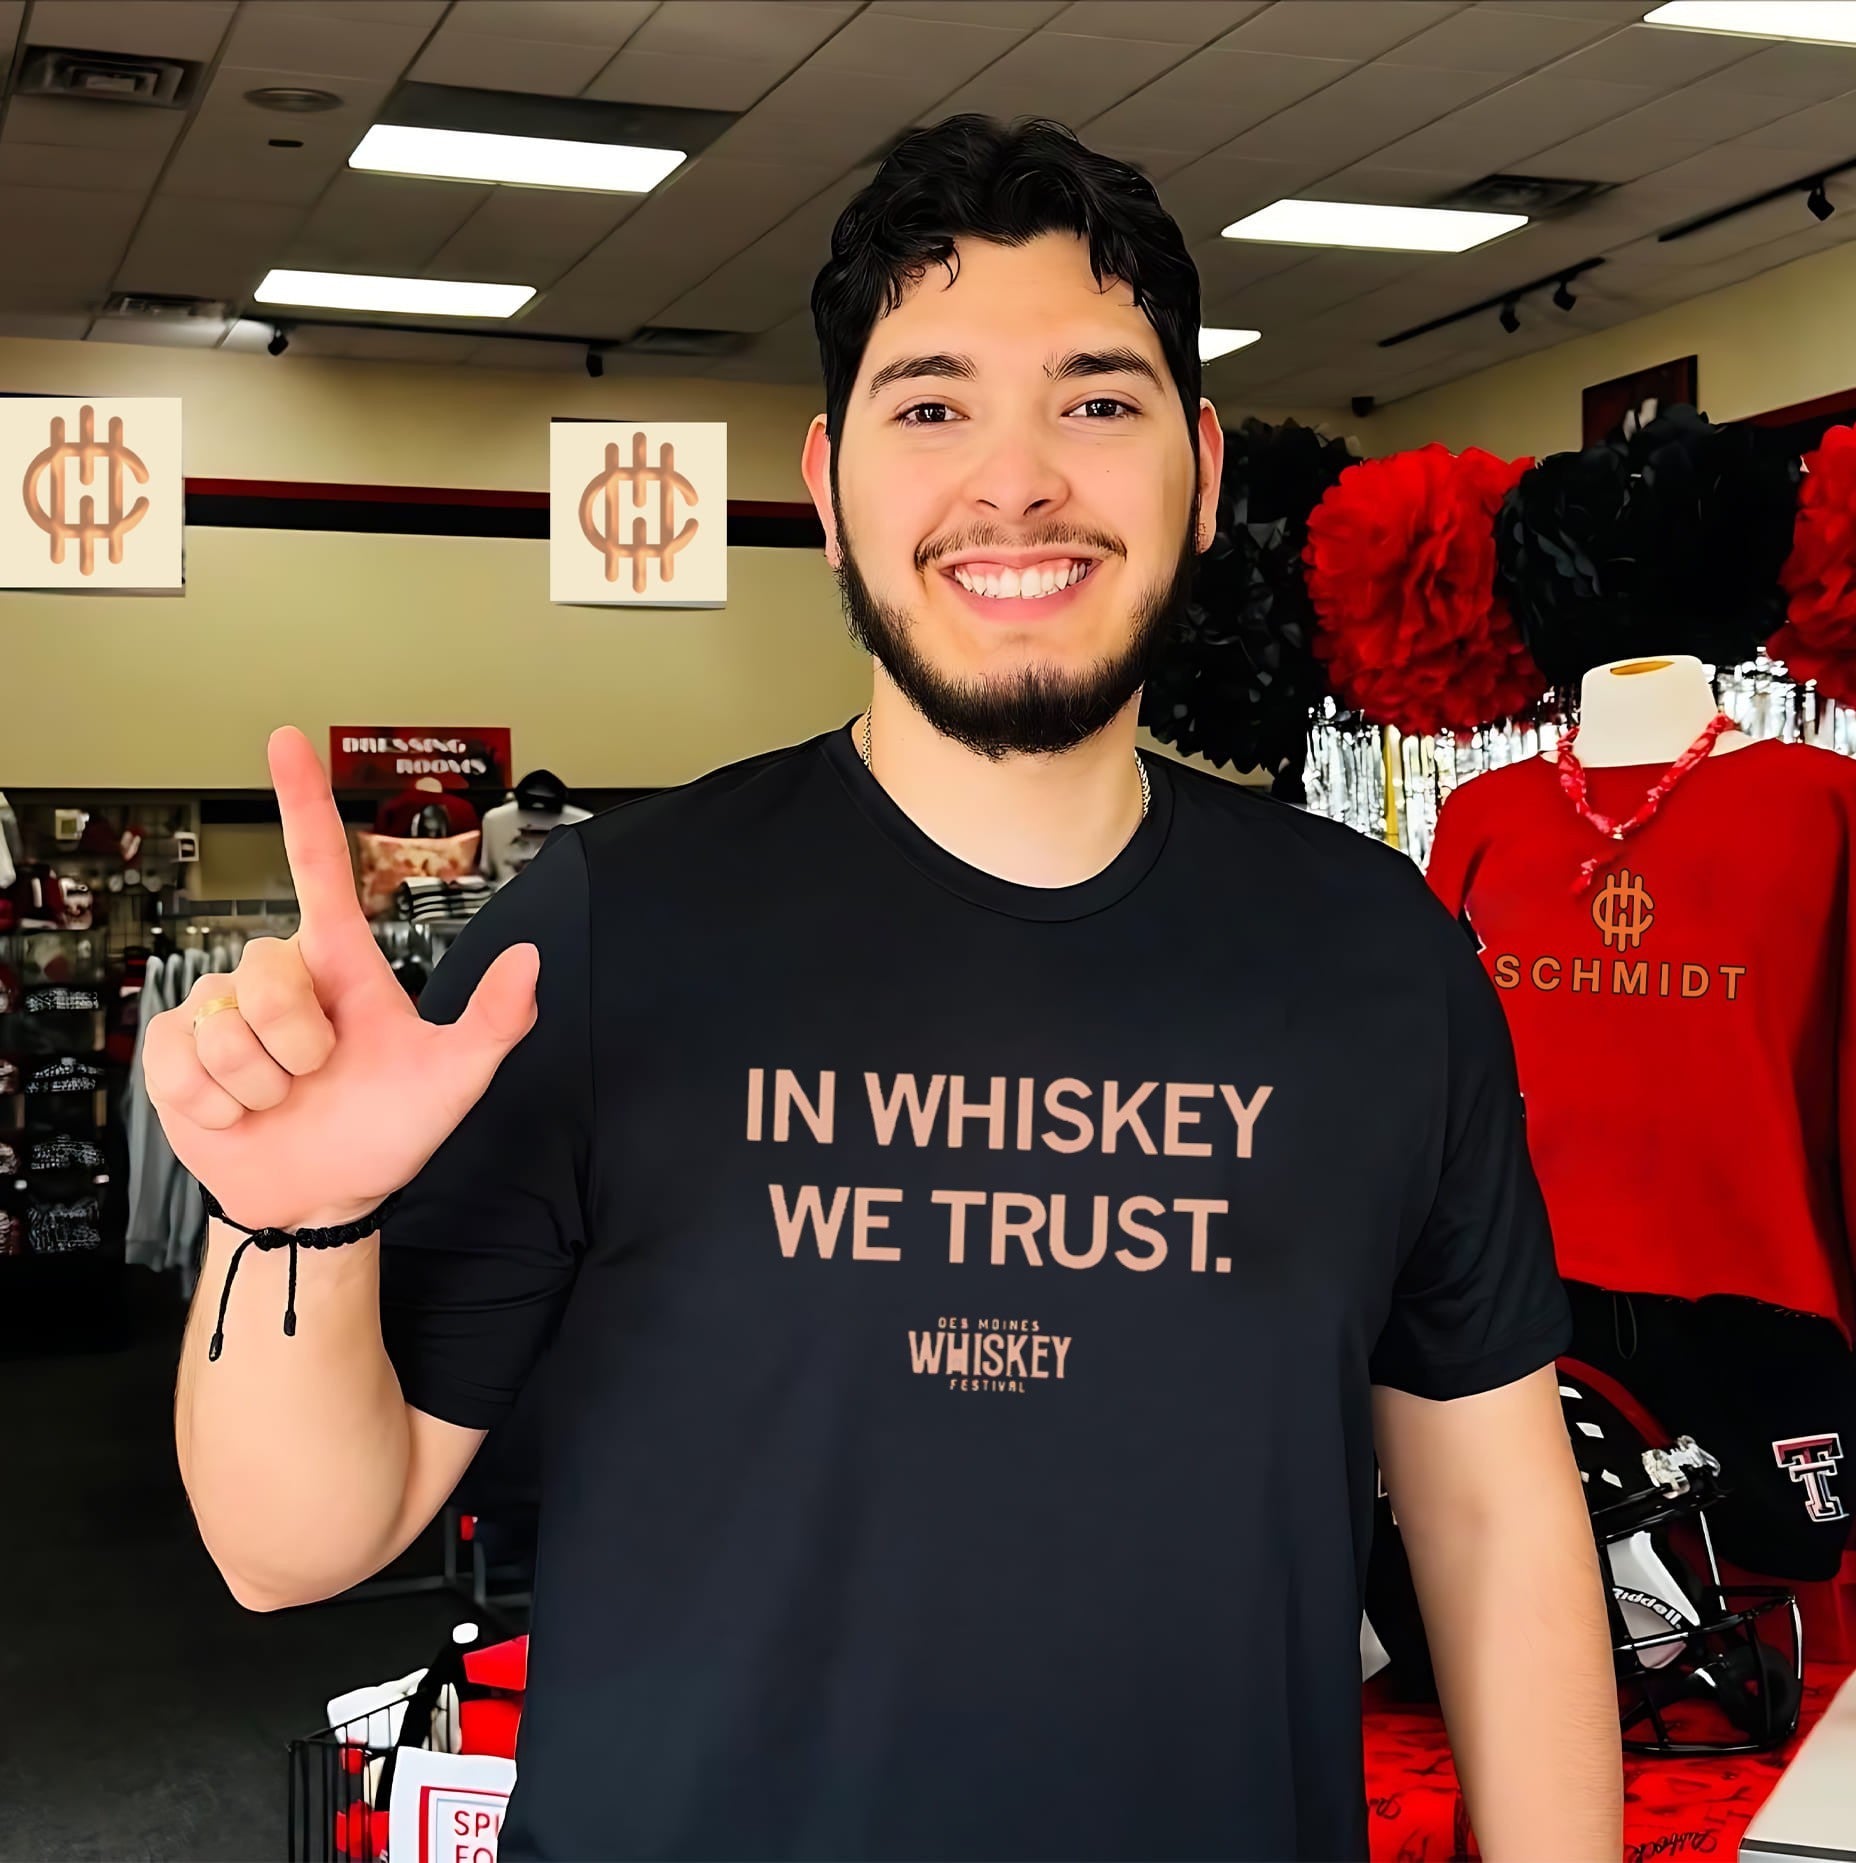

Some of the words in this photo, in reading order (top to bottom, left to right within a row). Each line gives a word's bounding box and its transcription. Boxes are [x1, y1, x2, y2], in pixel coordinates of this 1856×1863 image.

[396, 758, 487, 775] ROOMS
[1494, 953, 1747, 1000] SCHMIDT
[746, 1067, 836, 1144] IN
[863, 1071, 1274, 1159] WHISKEY
[768, 1184, 904, 1262] WE
[931, 1189, 1232, 1273] TRUST.
[978, 1318, 1041, 1332] MOINES
[908, 1330, 1072, 1379] WHISKEY
[950, 1379, 1025, 1393] FESTIVAL
